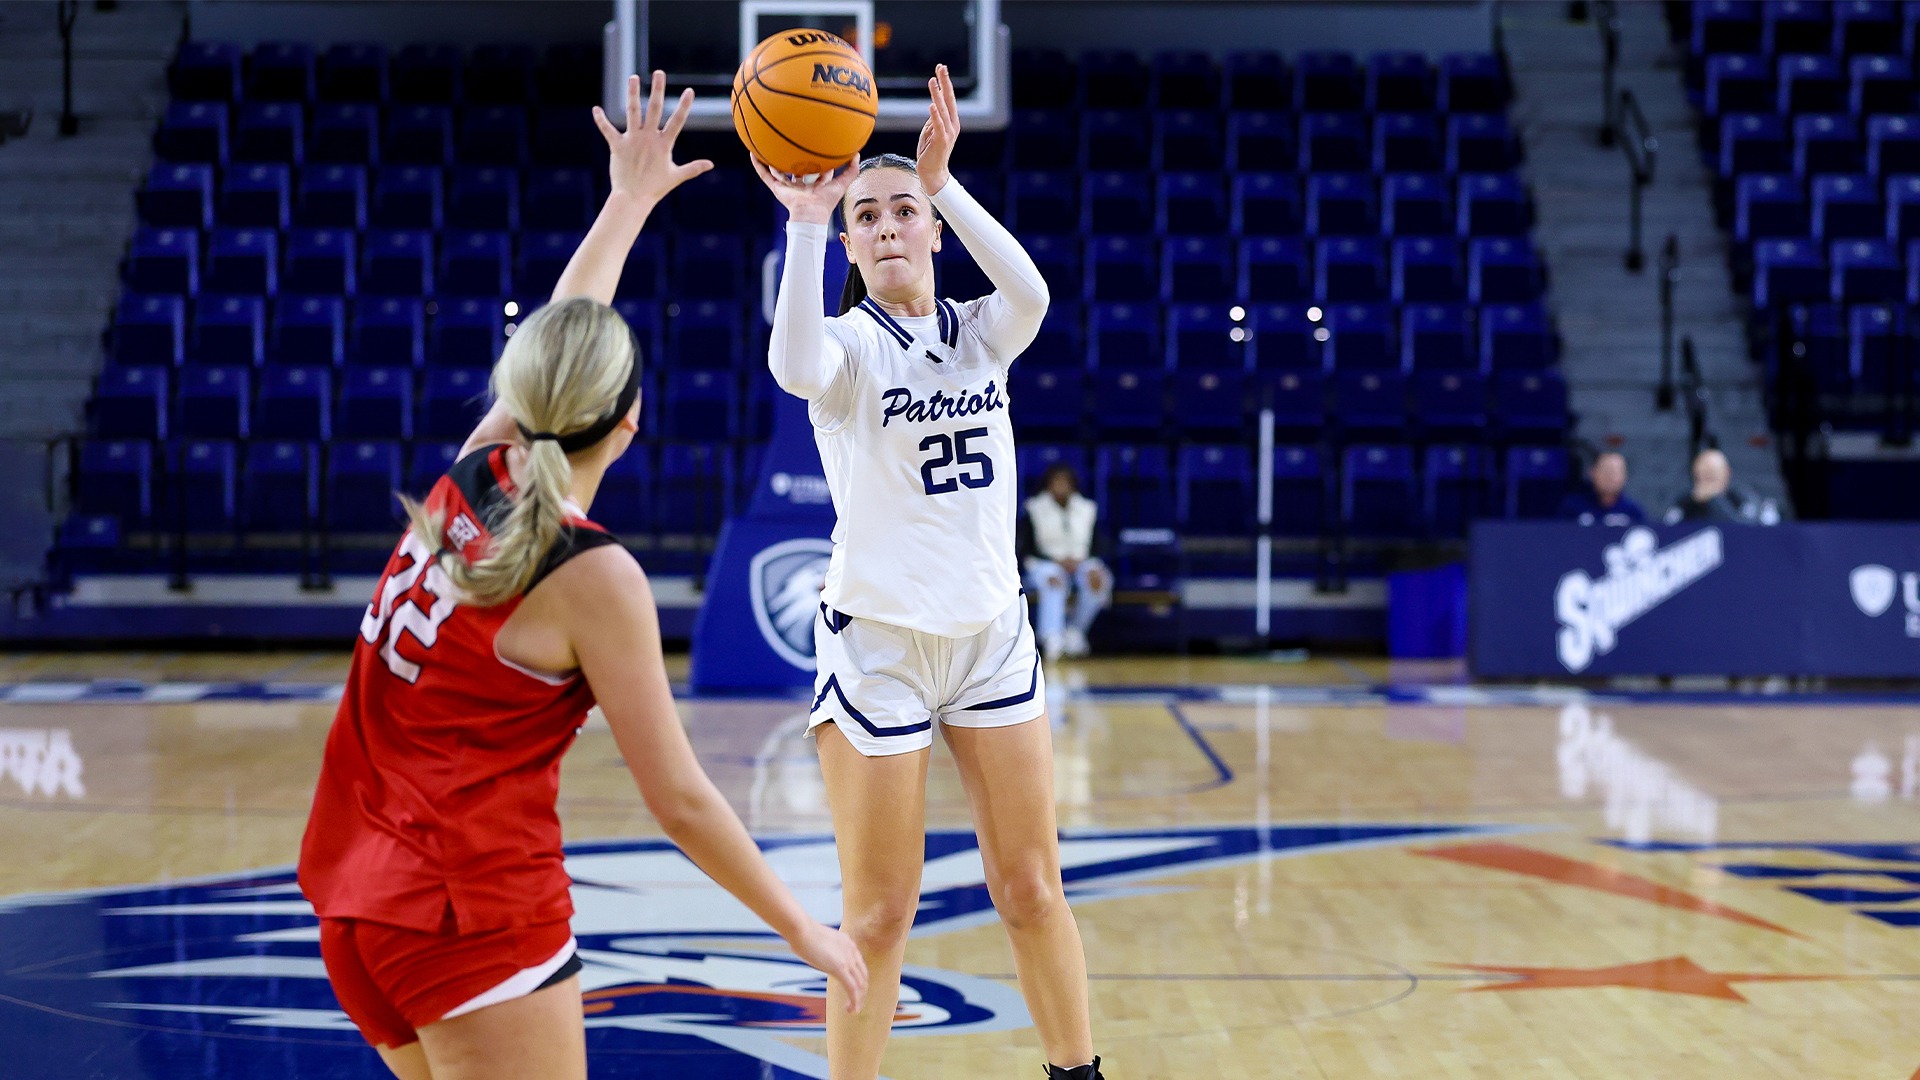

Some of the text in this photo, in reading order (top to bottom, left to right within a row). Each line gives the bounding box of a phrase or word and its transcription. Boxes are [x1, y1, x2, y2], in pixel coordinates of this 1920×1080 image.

[811, 63, 871, 98] NCAA
[918, 426, 995, 496] 25
[360, 532, 465, 684] 32
